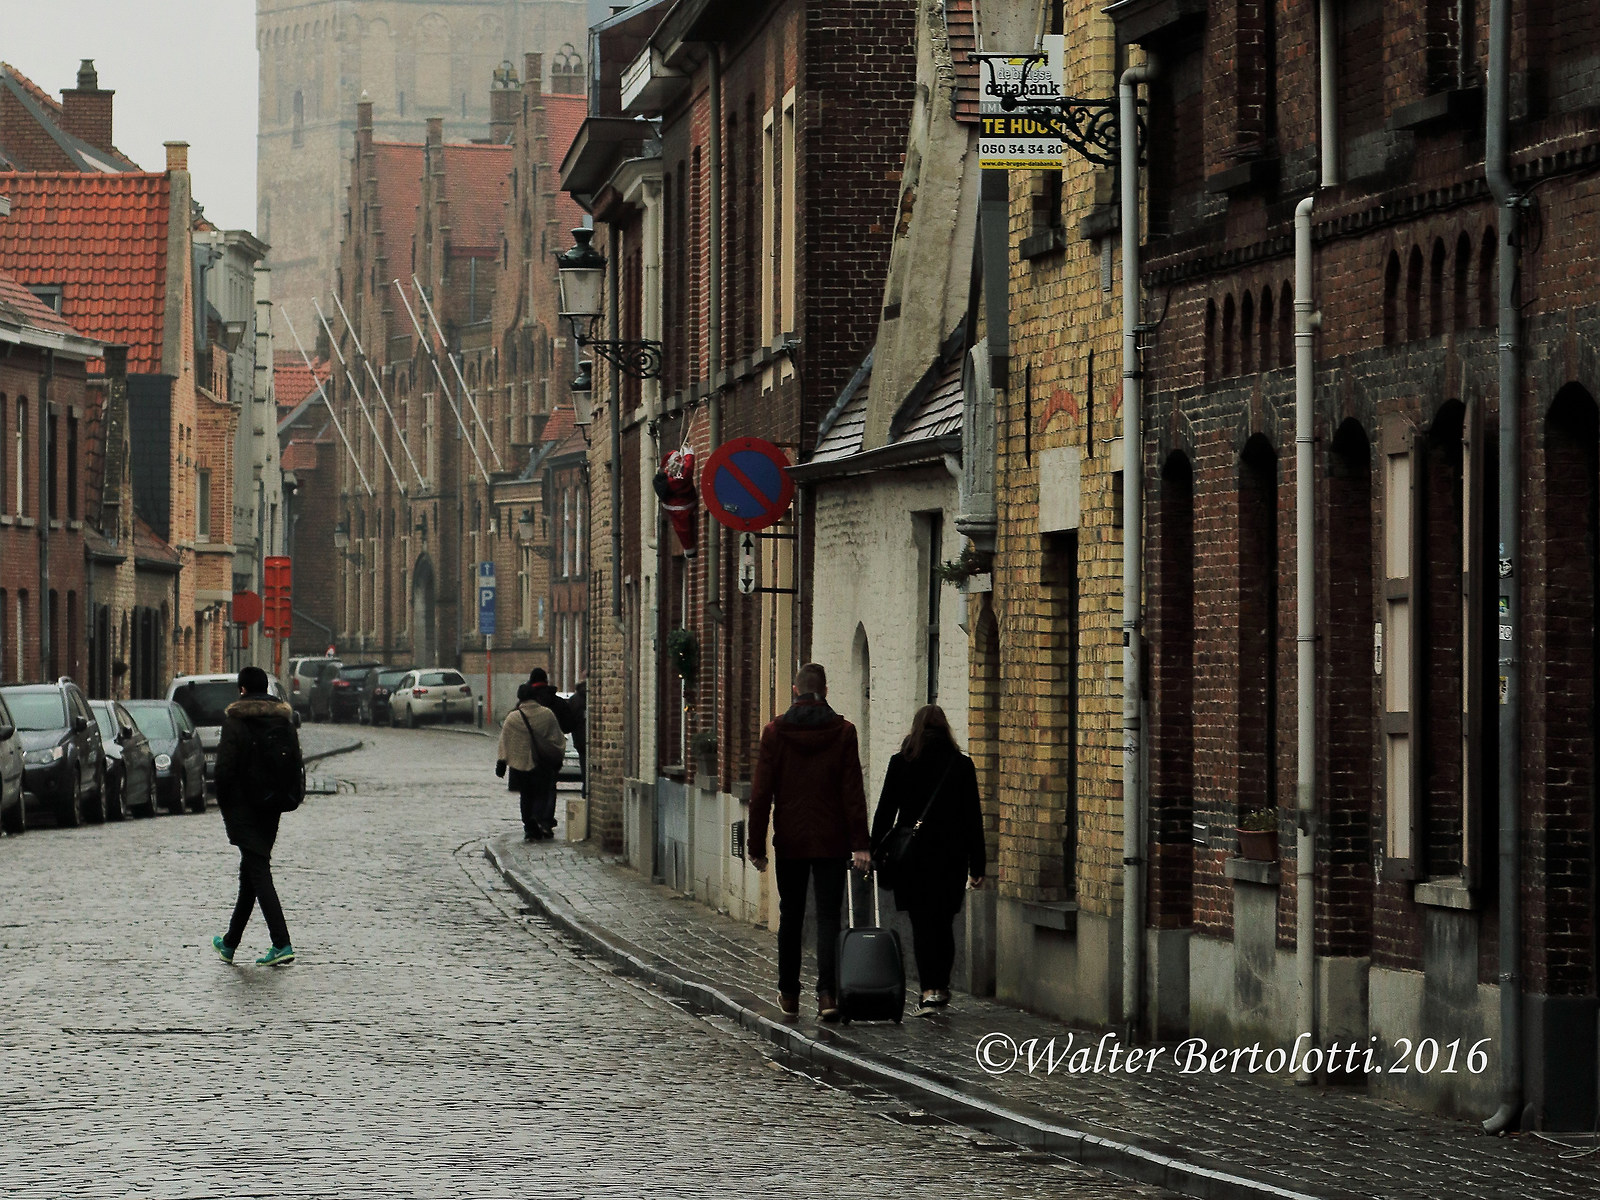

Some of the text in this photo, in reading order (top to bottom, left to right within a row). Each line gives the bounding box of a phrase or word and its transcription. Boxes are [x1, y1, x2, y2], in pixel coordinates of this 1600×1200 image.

[997, 67, 1052, 83] de bgse
[985, 80, 1060, 96] databank
[982, 118, 1005, 134] TE
[982, 144, 1063, 154] 050 34 34 20
[481, 589, 494, 607] P
